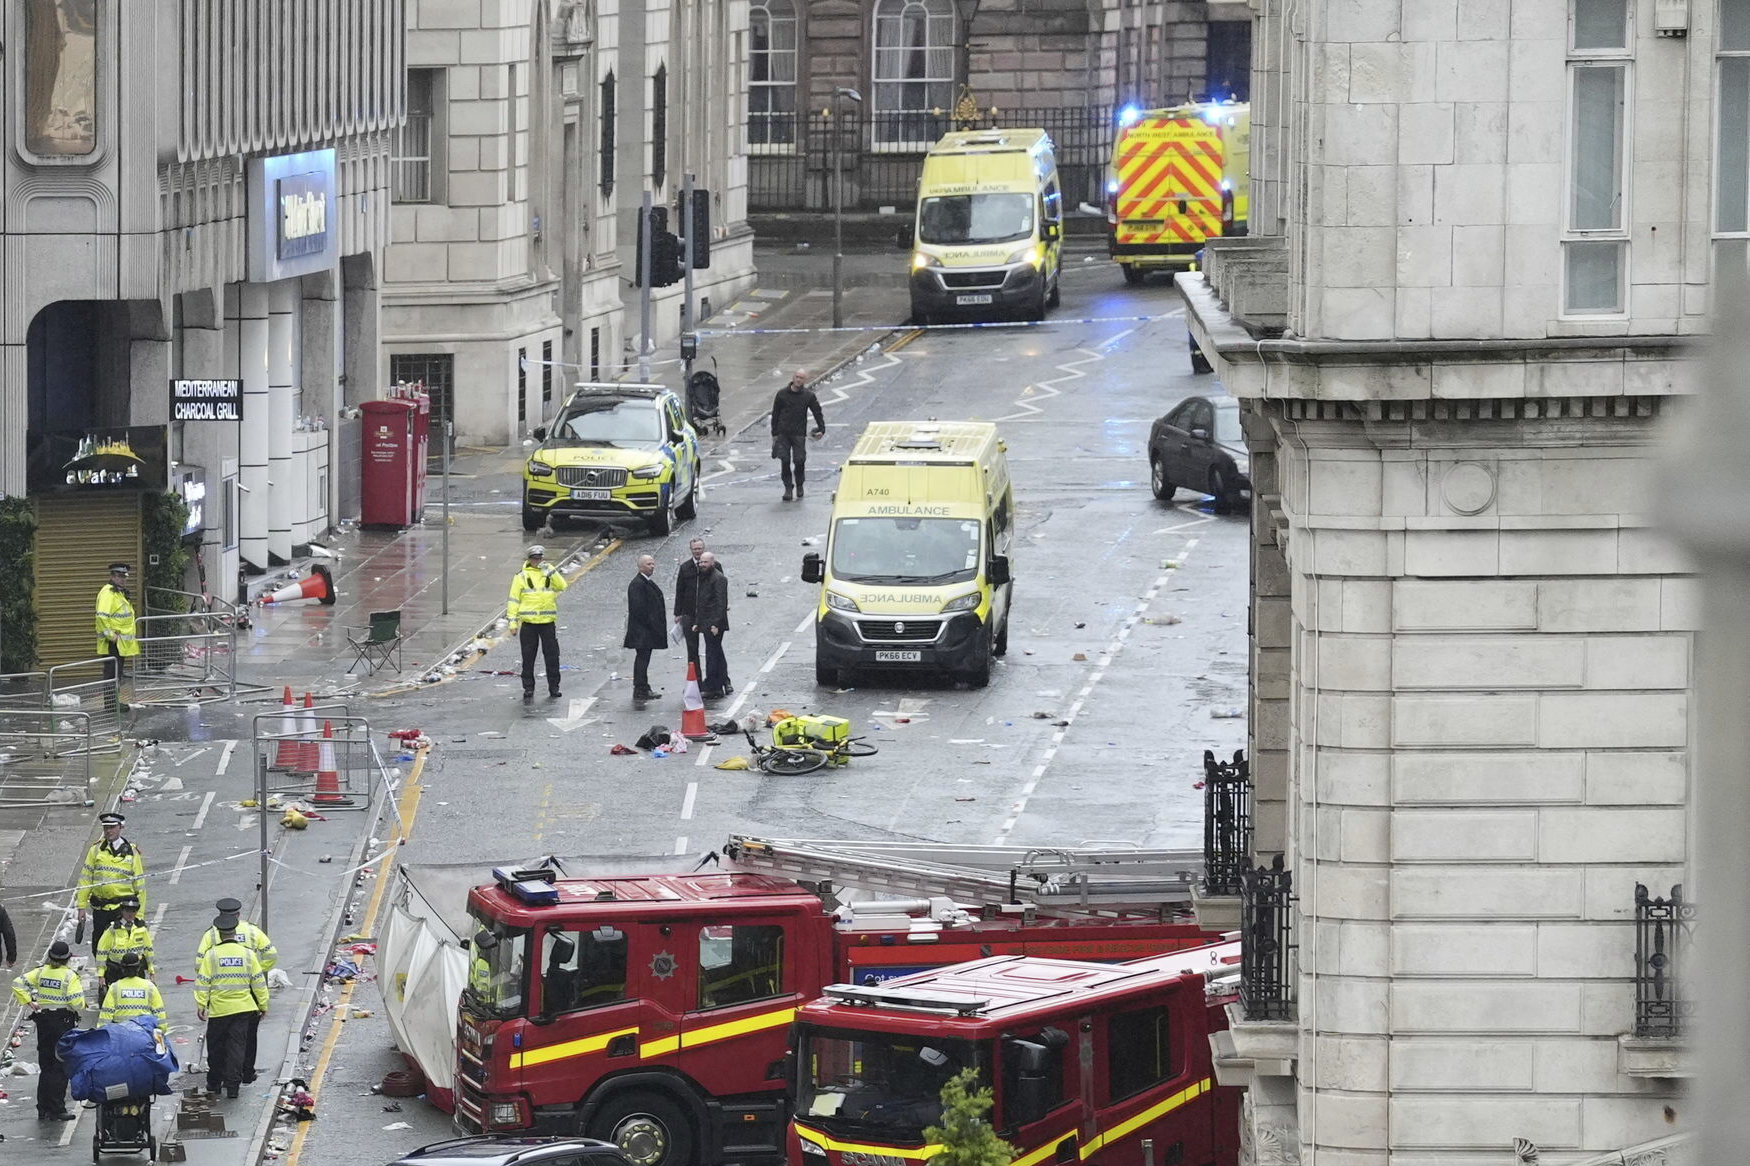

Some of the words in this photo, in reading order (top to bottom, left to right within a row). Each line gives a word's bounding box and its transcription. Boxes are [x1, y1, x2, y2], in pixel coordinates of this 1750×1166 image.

[174, 380, 238, 397] MEDITERRANEAN
[175, 402, 216, 419] CHARCOAL
[216, 402, 239, 419] GRILL
[866, 488, 890, 496] A740
[867, 506, 950, 516] AMBULANCE
[879, 652, 900, 660] PK66
[220, 958, 243, 967] POLICE
[40, 978, 61, 989] POLICE
[122, 989, 145, 998] POLICE
